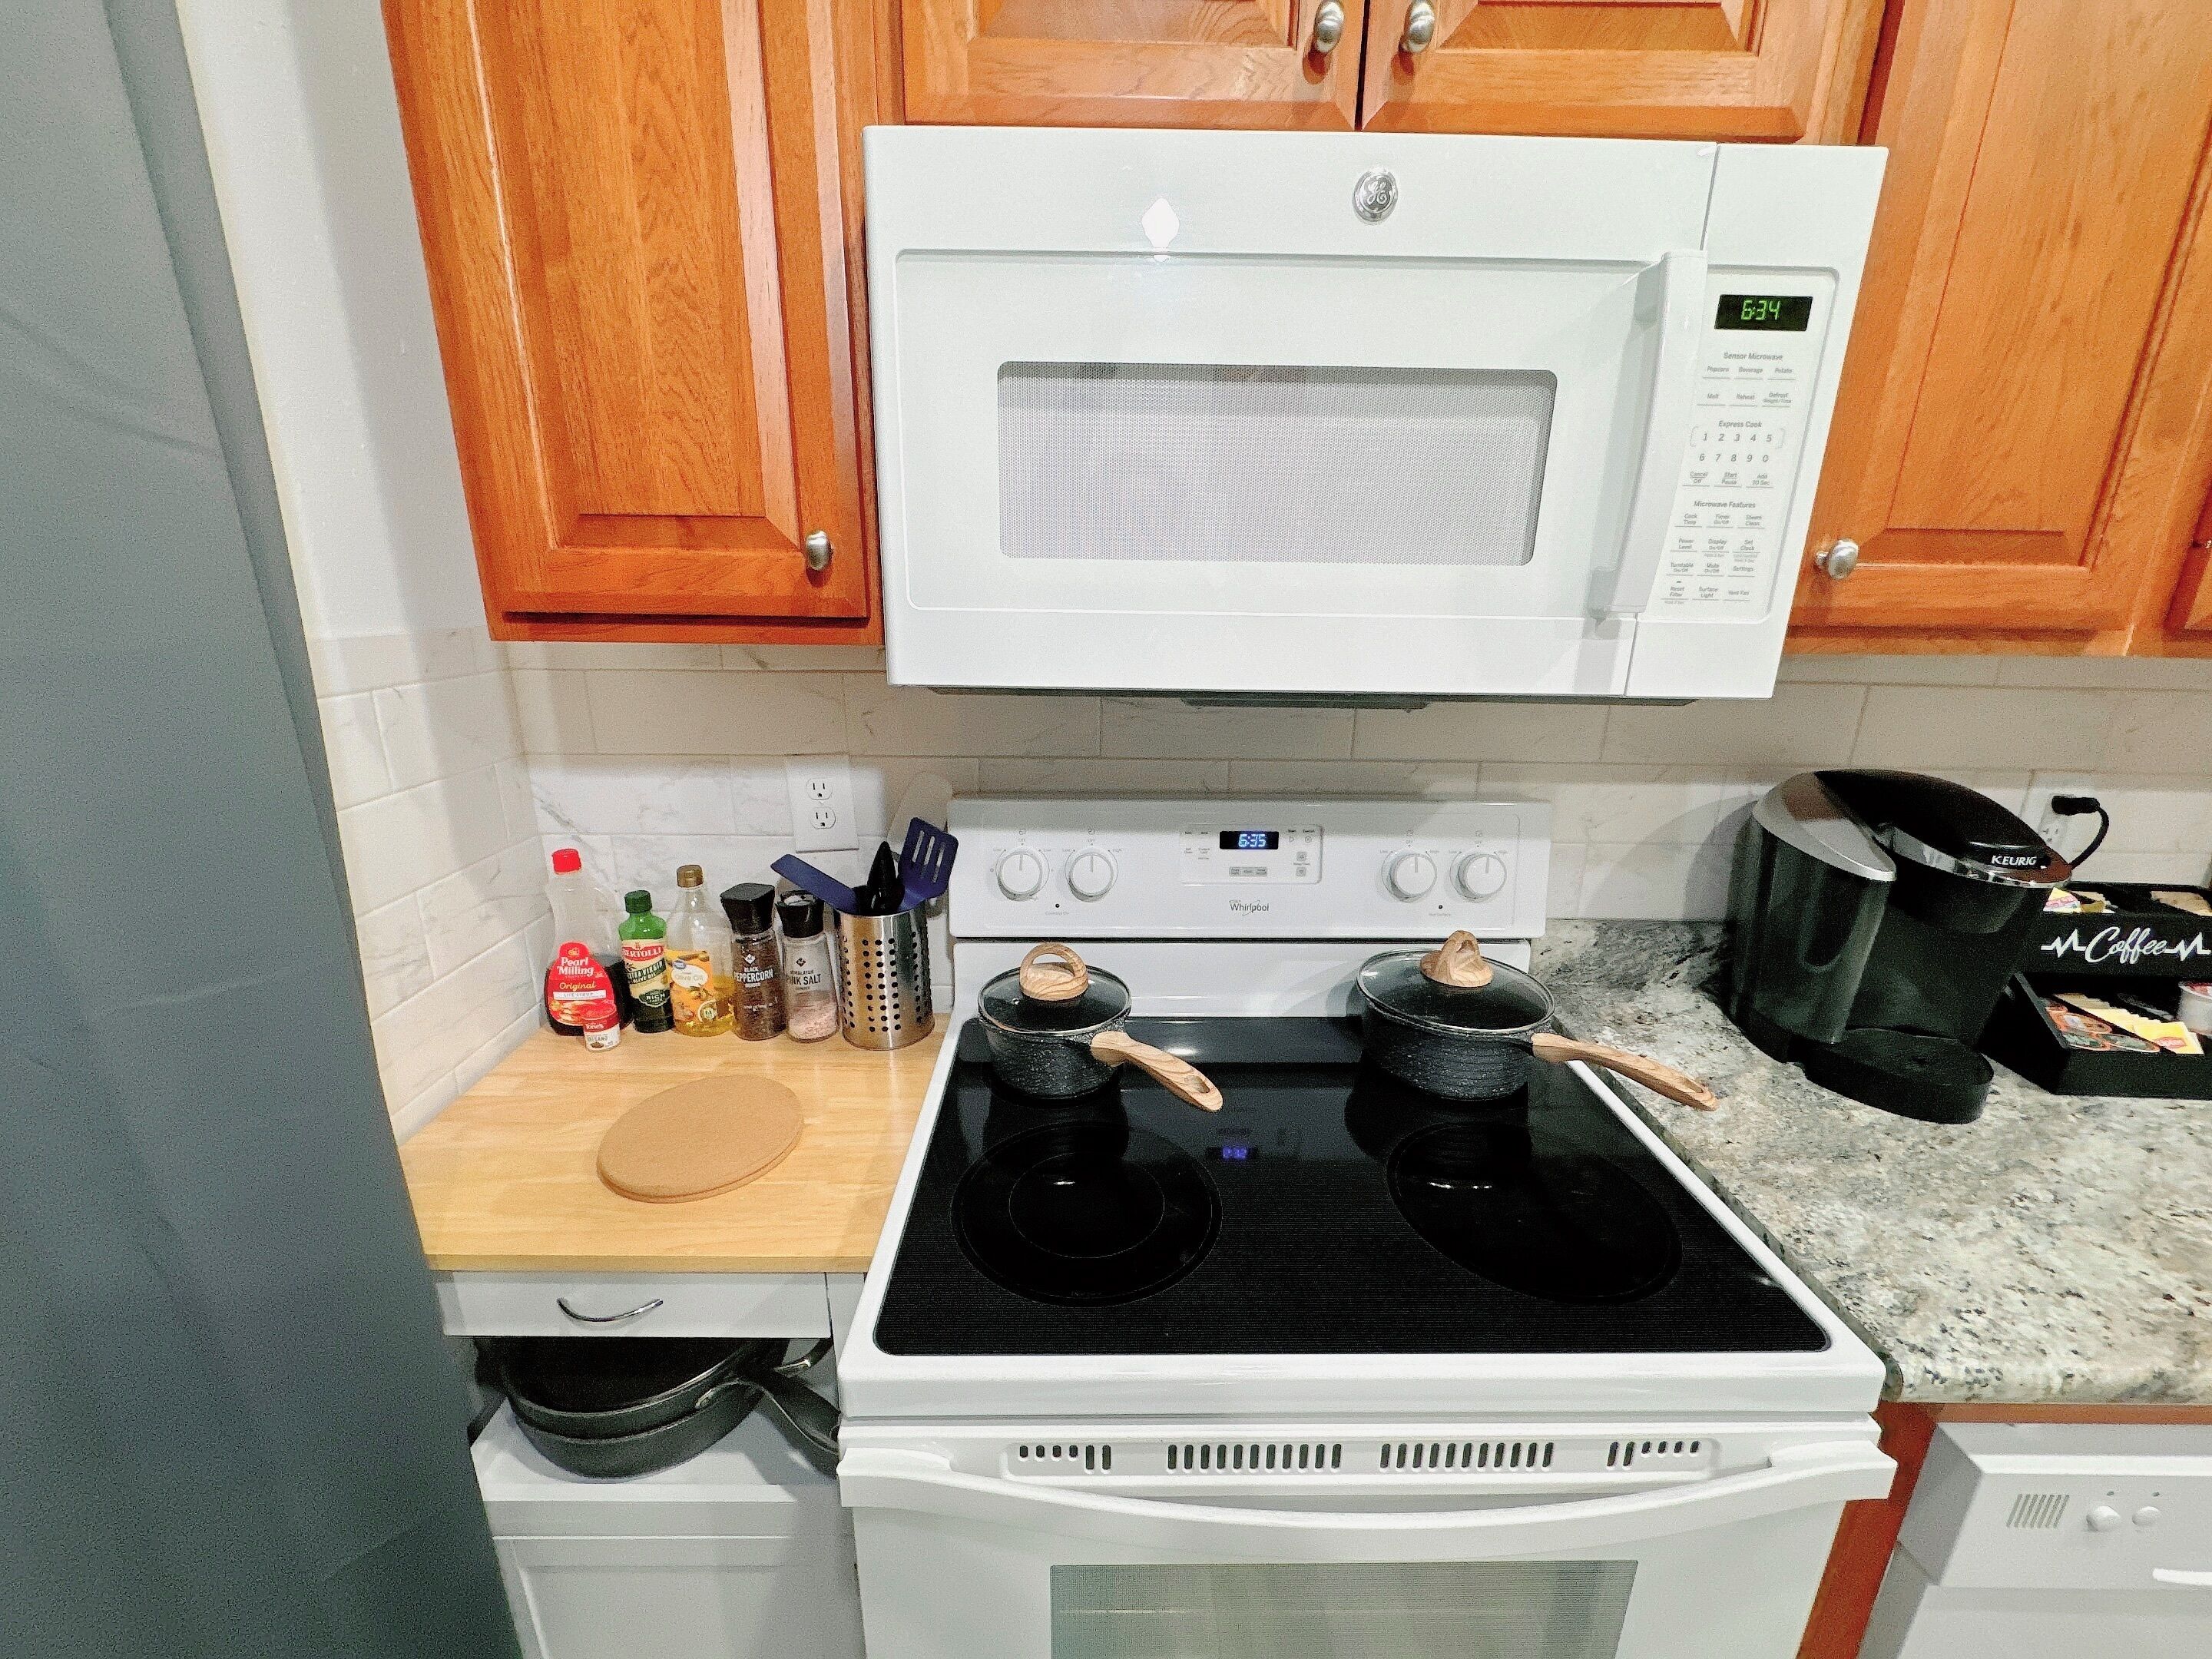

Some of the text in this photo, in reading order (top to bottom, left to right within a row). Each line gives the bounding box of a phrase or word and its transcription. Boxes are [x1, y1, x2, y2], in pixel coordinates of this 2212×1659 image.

[1740, 299, 1781, 320] 6:34
[1748, 353, 1783, 361] Microwave
[1703, 432, 1708, 442] 1
[1718, 433, 1724, 442] 2
[1734, 433, 1740, 442] 3
[1766, 434, 1772, 442] 5
[1716, 453, 1721, 462] 7
[1747, 454, 1753, 462] 9
[1238, 833, 1267, 847] 6:35
[1991, 855, 2037, 866] KEURIG
[1230, 902, 1270, 912] Whirlpool
[2085, 926, 2167, 964] Coffee
[561, 956, 589, 966] Pearl
[557, 965, 594, 977] Milling
[734, 968, 774, 983] PEPPERCORN
[803, 973, 821, 985] SALT
[559, 981, 597, 992] Original
